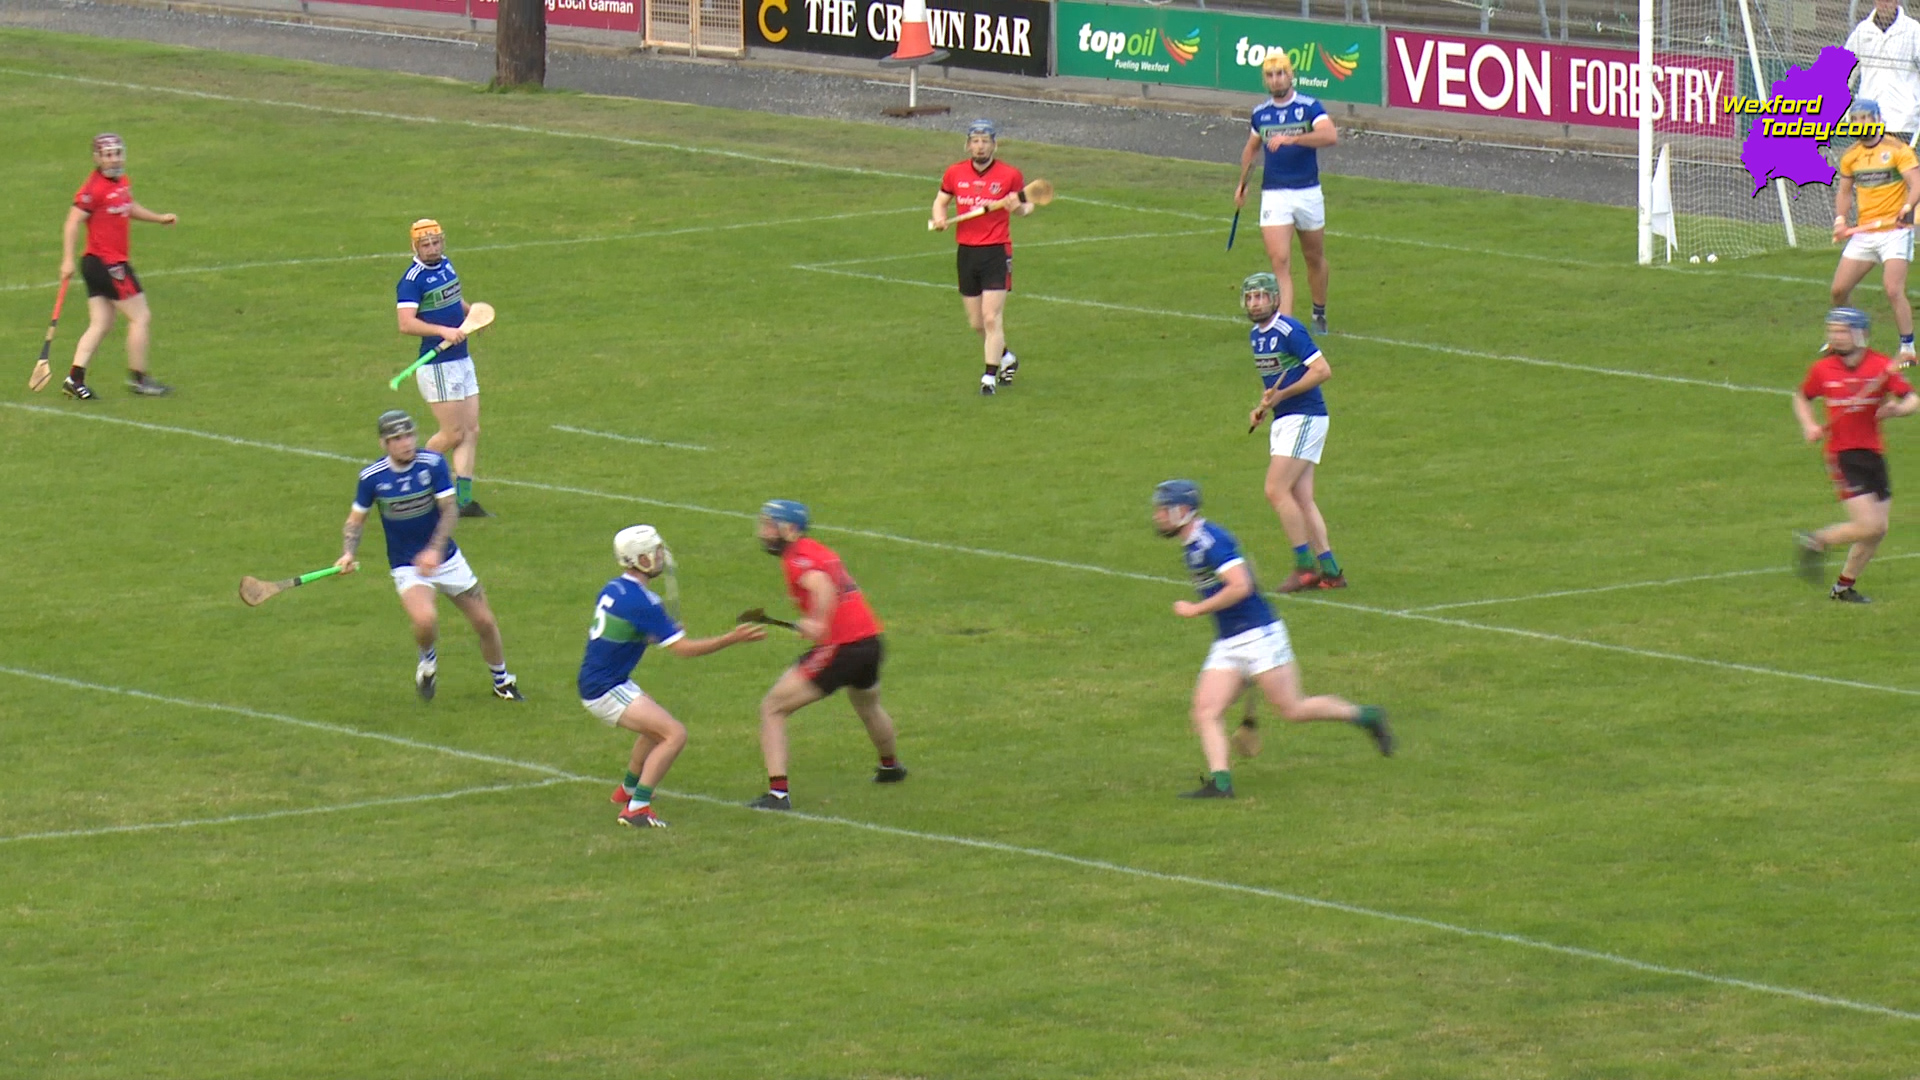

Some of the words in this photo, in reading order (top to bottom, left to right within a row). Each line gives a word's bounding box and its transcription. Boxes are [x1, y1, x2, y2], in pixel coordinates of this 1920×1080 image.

[589, 0, 634, 14] Garman
[804, 0, 858, 37] THE
[867, 2, 966, 48] CRWN
[973, 14, 1031, 57] BAR
[1115, 58, 1140, 73] Fueling
[1141, 61, 1169, 73] Wexford
[1299, 75, 1328, 89] Wexford
[1394, 37, 1551, 116] VEON
